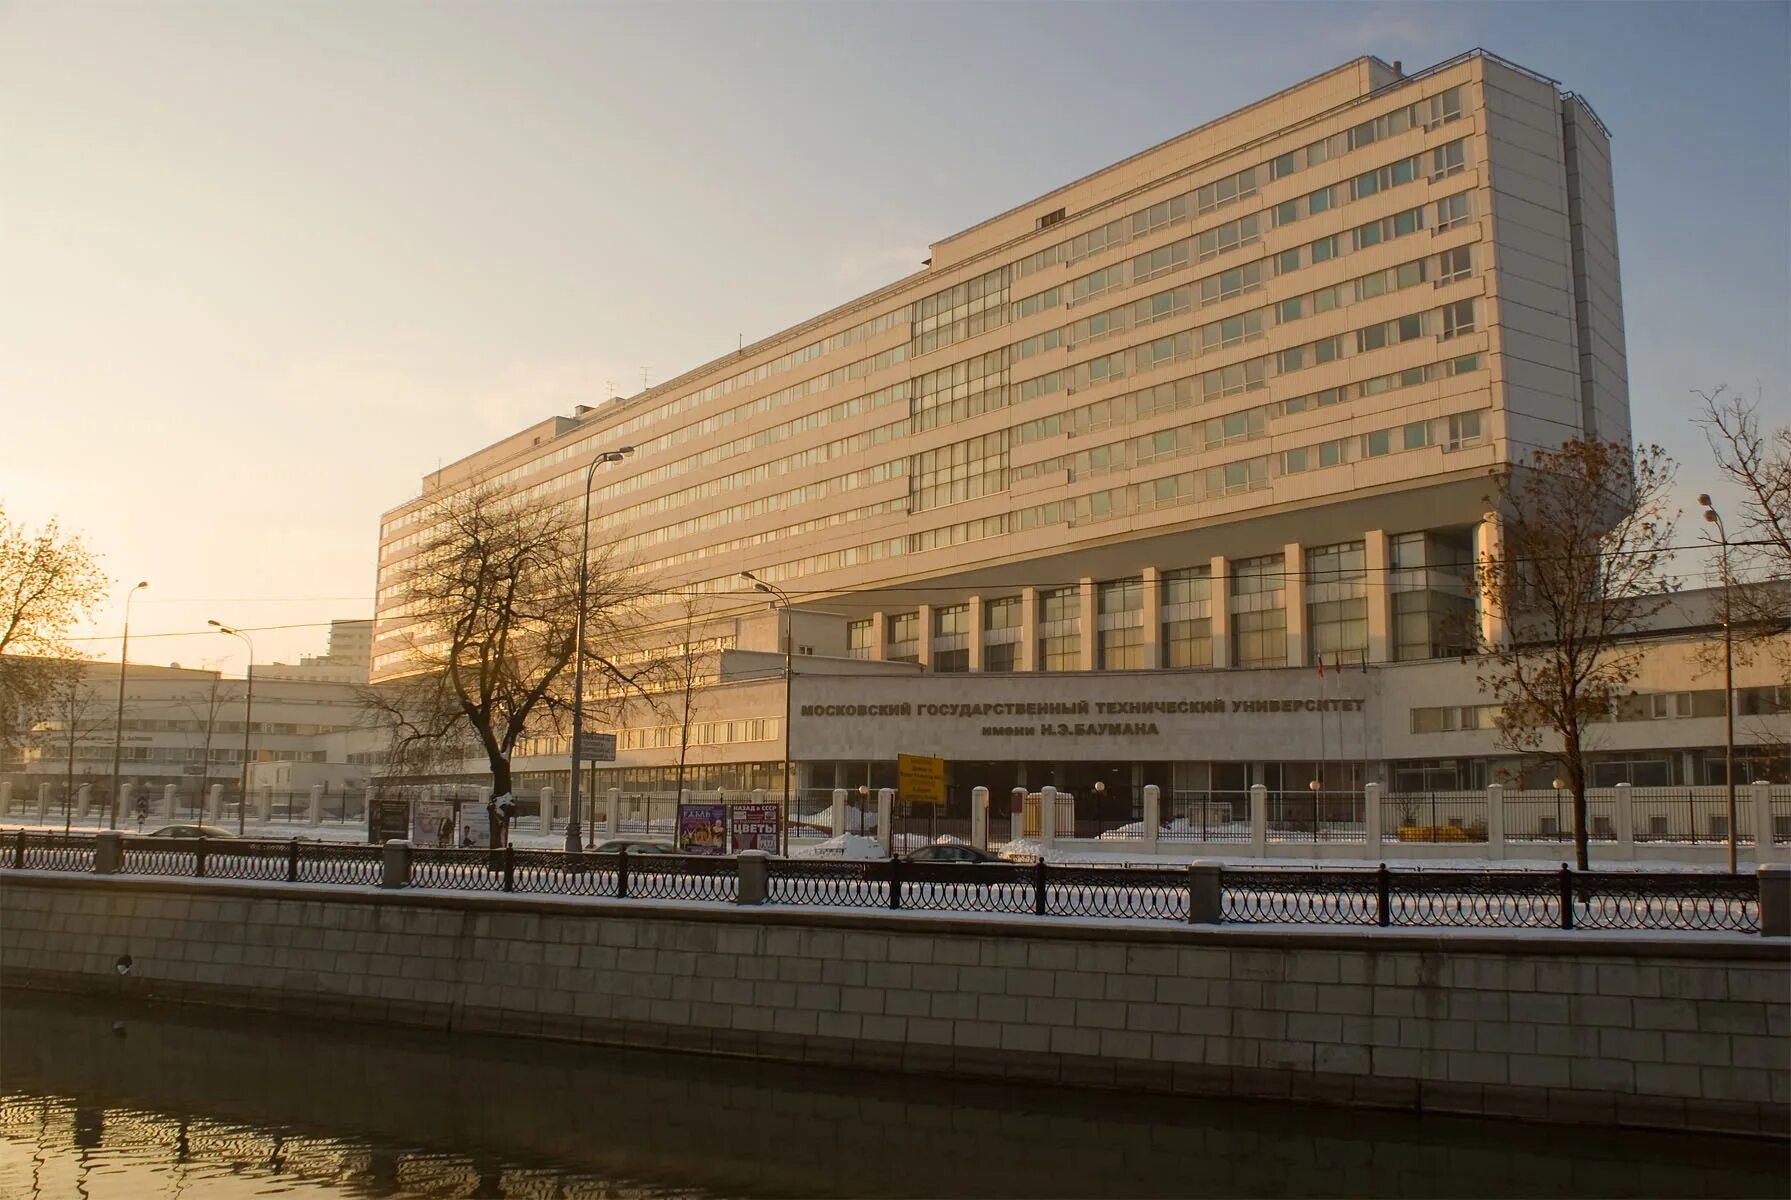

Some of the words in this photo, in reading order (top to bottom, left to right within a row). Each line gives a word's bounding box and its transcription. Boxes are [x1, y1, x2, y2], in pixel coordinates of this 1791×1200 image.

[801, 702, 911, 716] МОСКОВСКИЙ
[917, 700, 1089, 717] ГОСУДАРСТВЕННЫЙ
[1096, 698, 1226, 714] ТЕХНИЧЕСКИЙ
[1232, 699, 1365, 713] УНИВЕРСИТЕТ
[981, 725, 1035, 736] имени
[1040, 723, 1160, 737] Н.Э.БАУМАНА
[733, 824, 776, 834] ЦВЕТЫ
